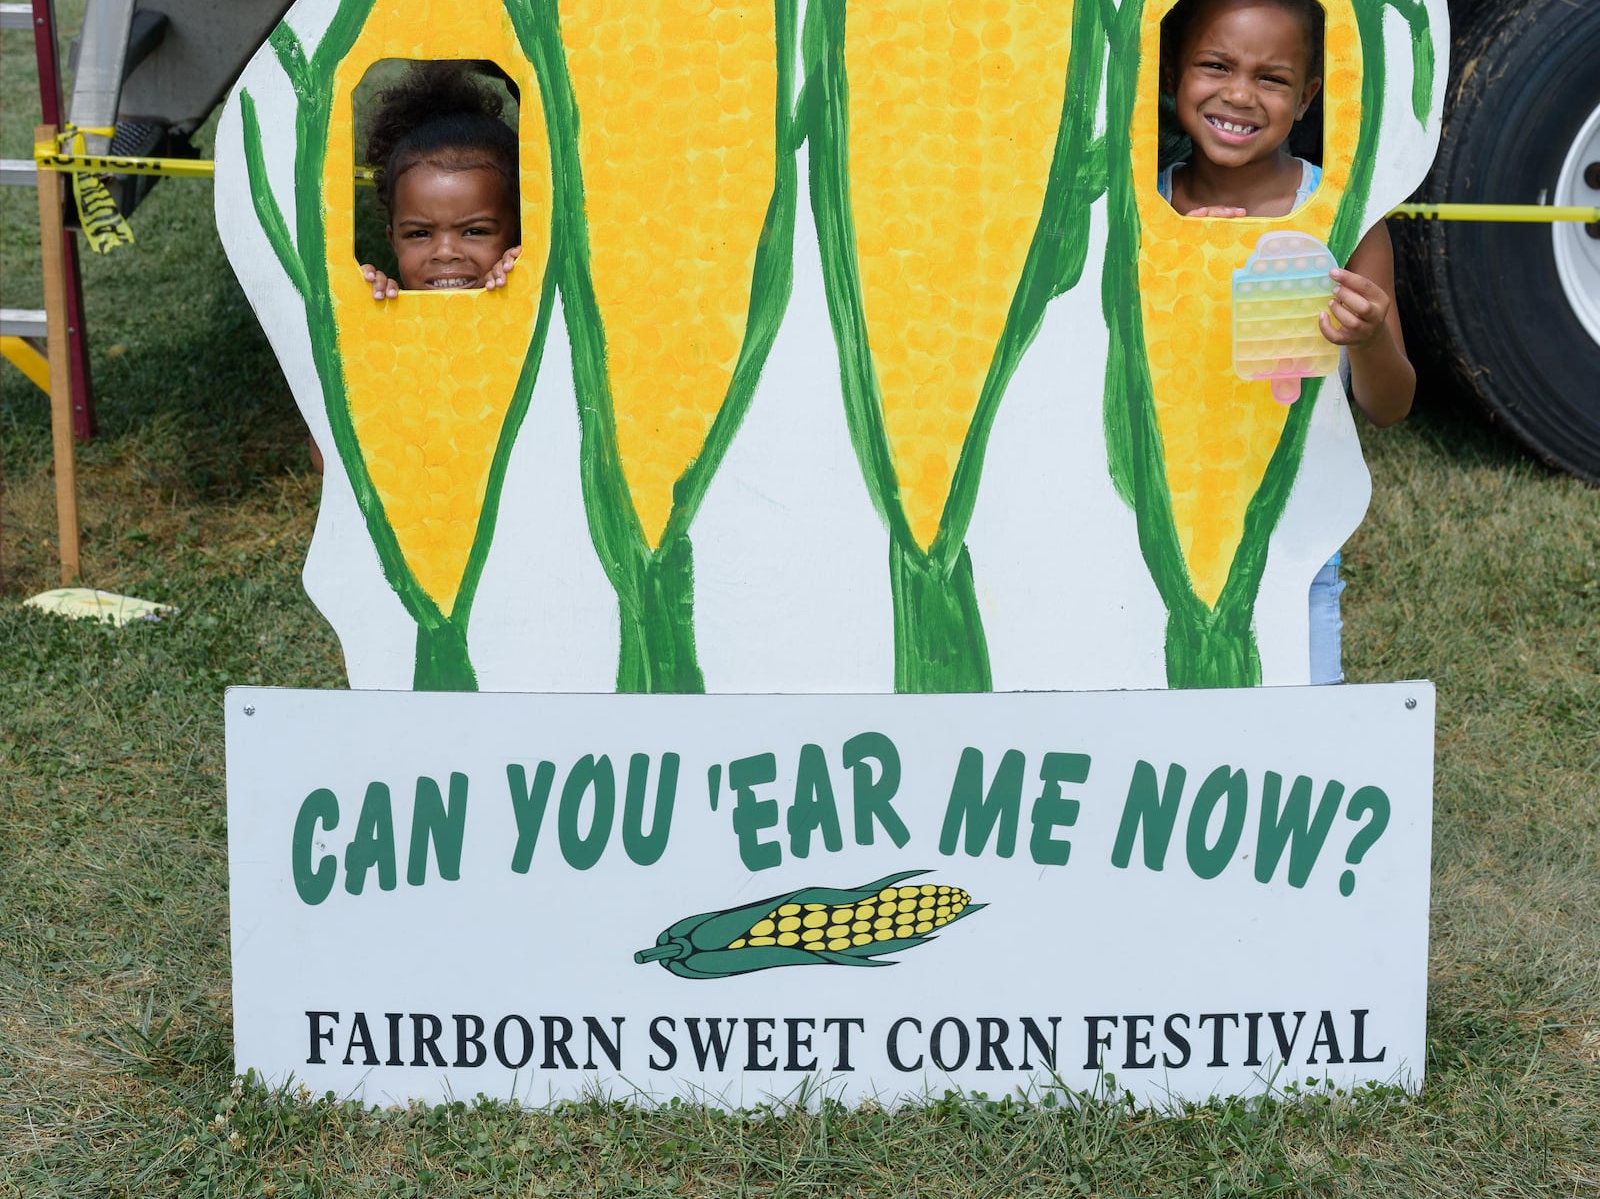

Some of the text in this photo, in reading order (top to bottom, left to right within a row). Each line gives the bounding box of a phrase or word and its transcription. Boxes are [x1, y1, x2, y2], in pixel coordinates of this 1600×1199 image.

[292, 732, 1391, 906] CAN YOU 'EAR ME NOW?
[305, 1009, 1387, 1073] FAIRBORN SWEET CORN FESTIVAL
